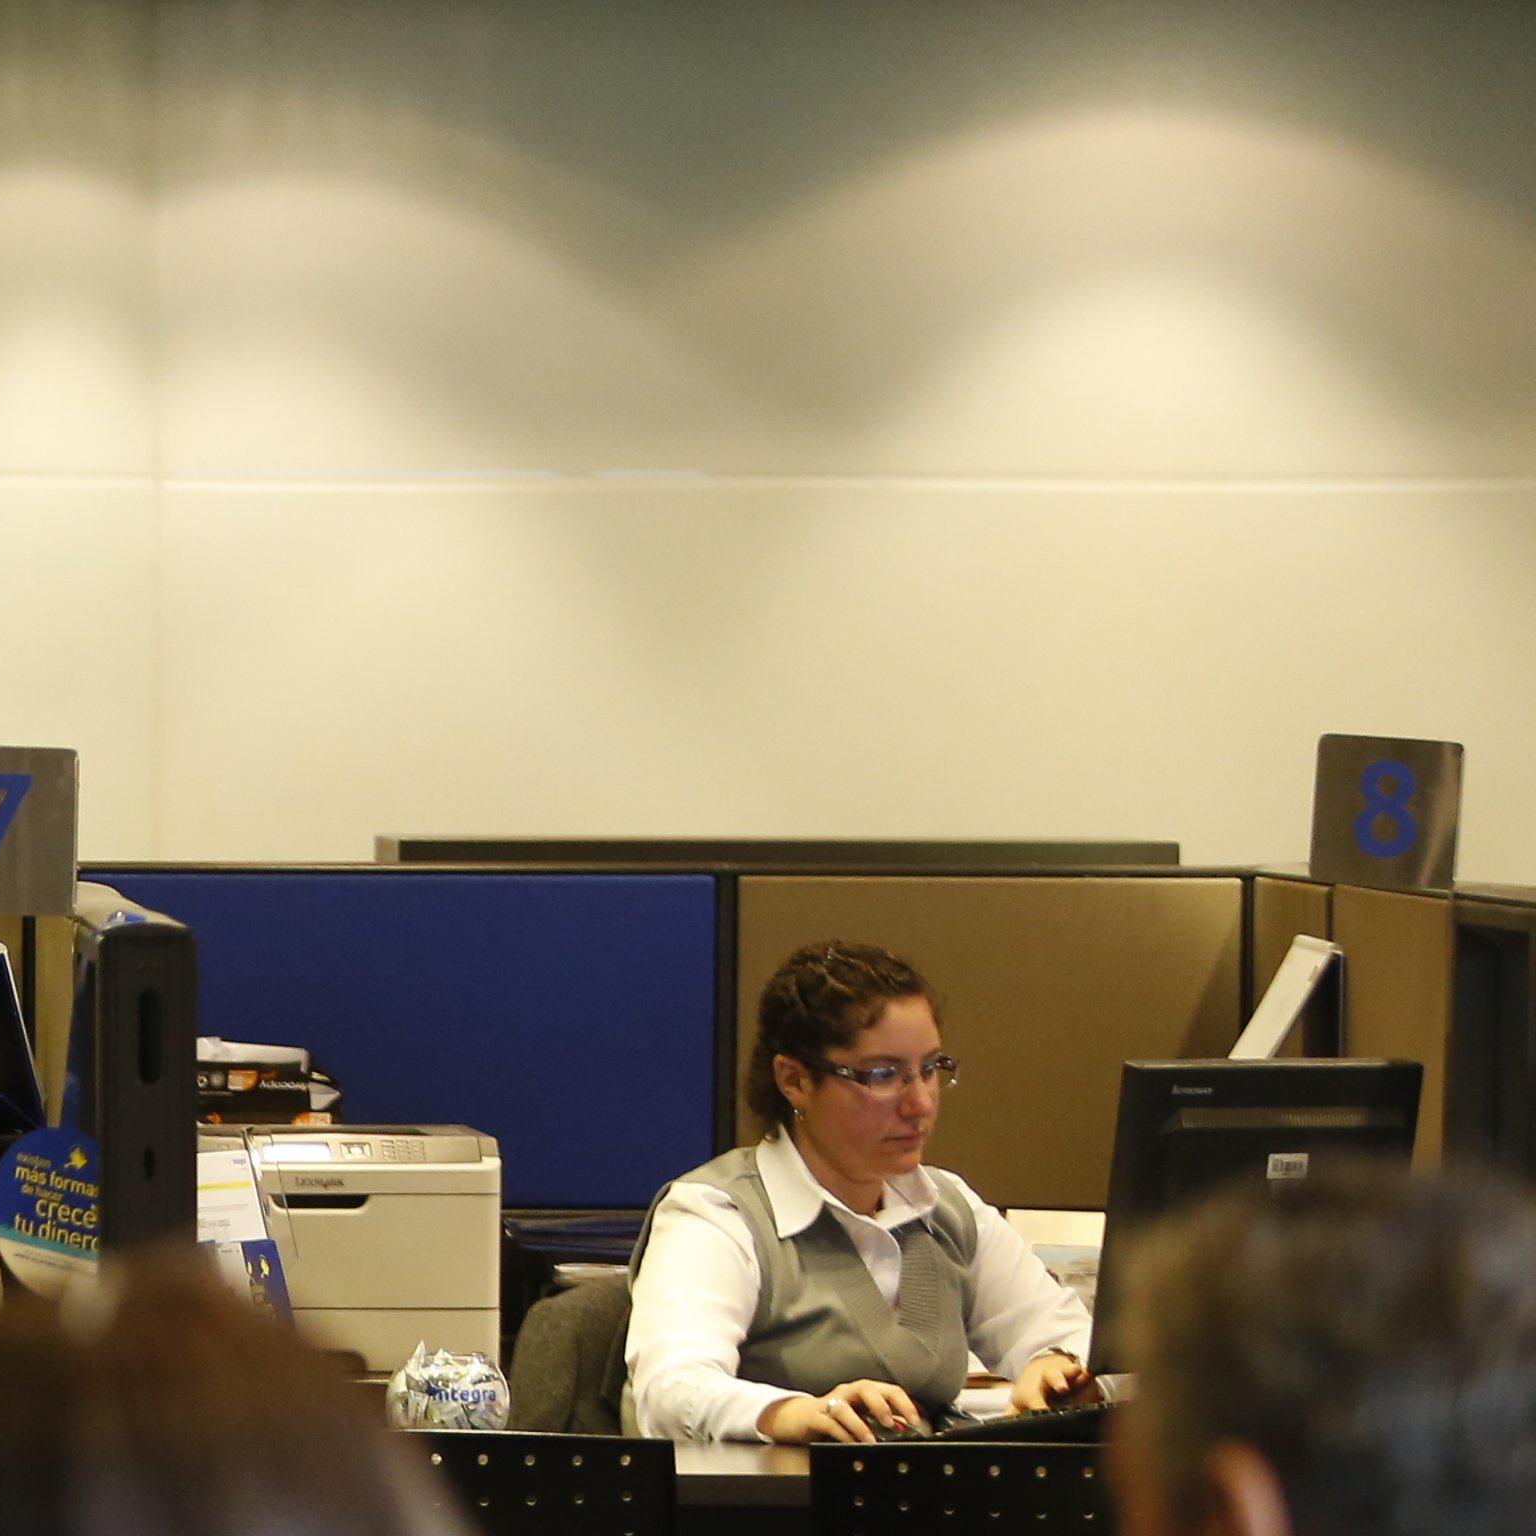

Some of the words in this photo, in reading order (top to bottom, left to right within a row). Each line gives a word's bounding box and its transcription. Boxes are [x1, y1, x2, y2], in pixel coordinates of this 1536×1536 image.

[1354, 759, 1418, 858] 8
[15, 1165, 48, 1185] más
[14, 1213, 34, 1237] tu
[431, 1387, 496, 1404] ntegra
